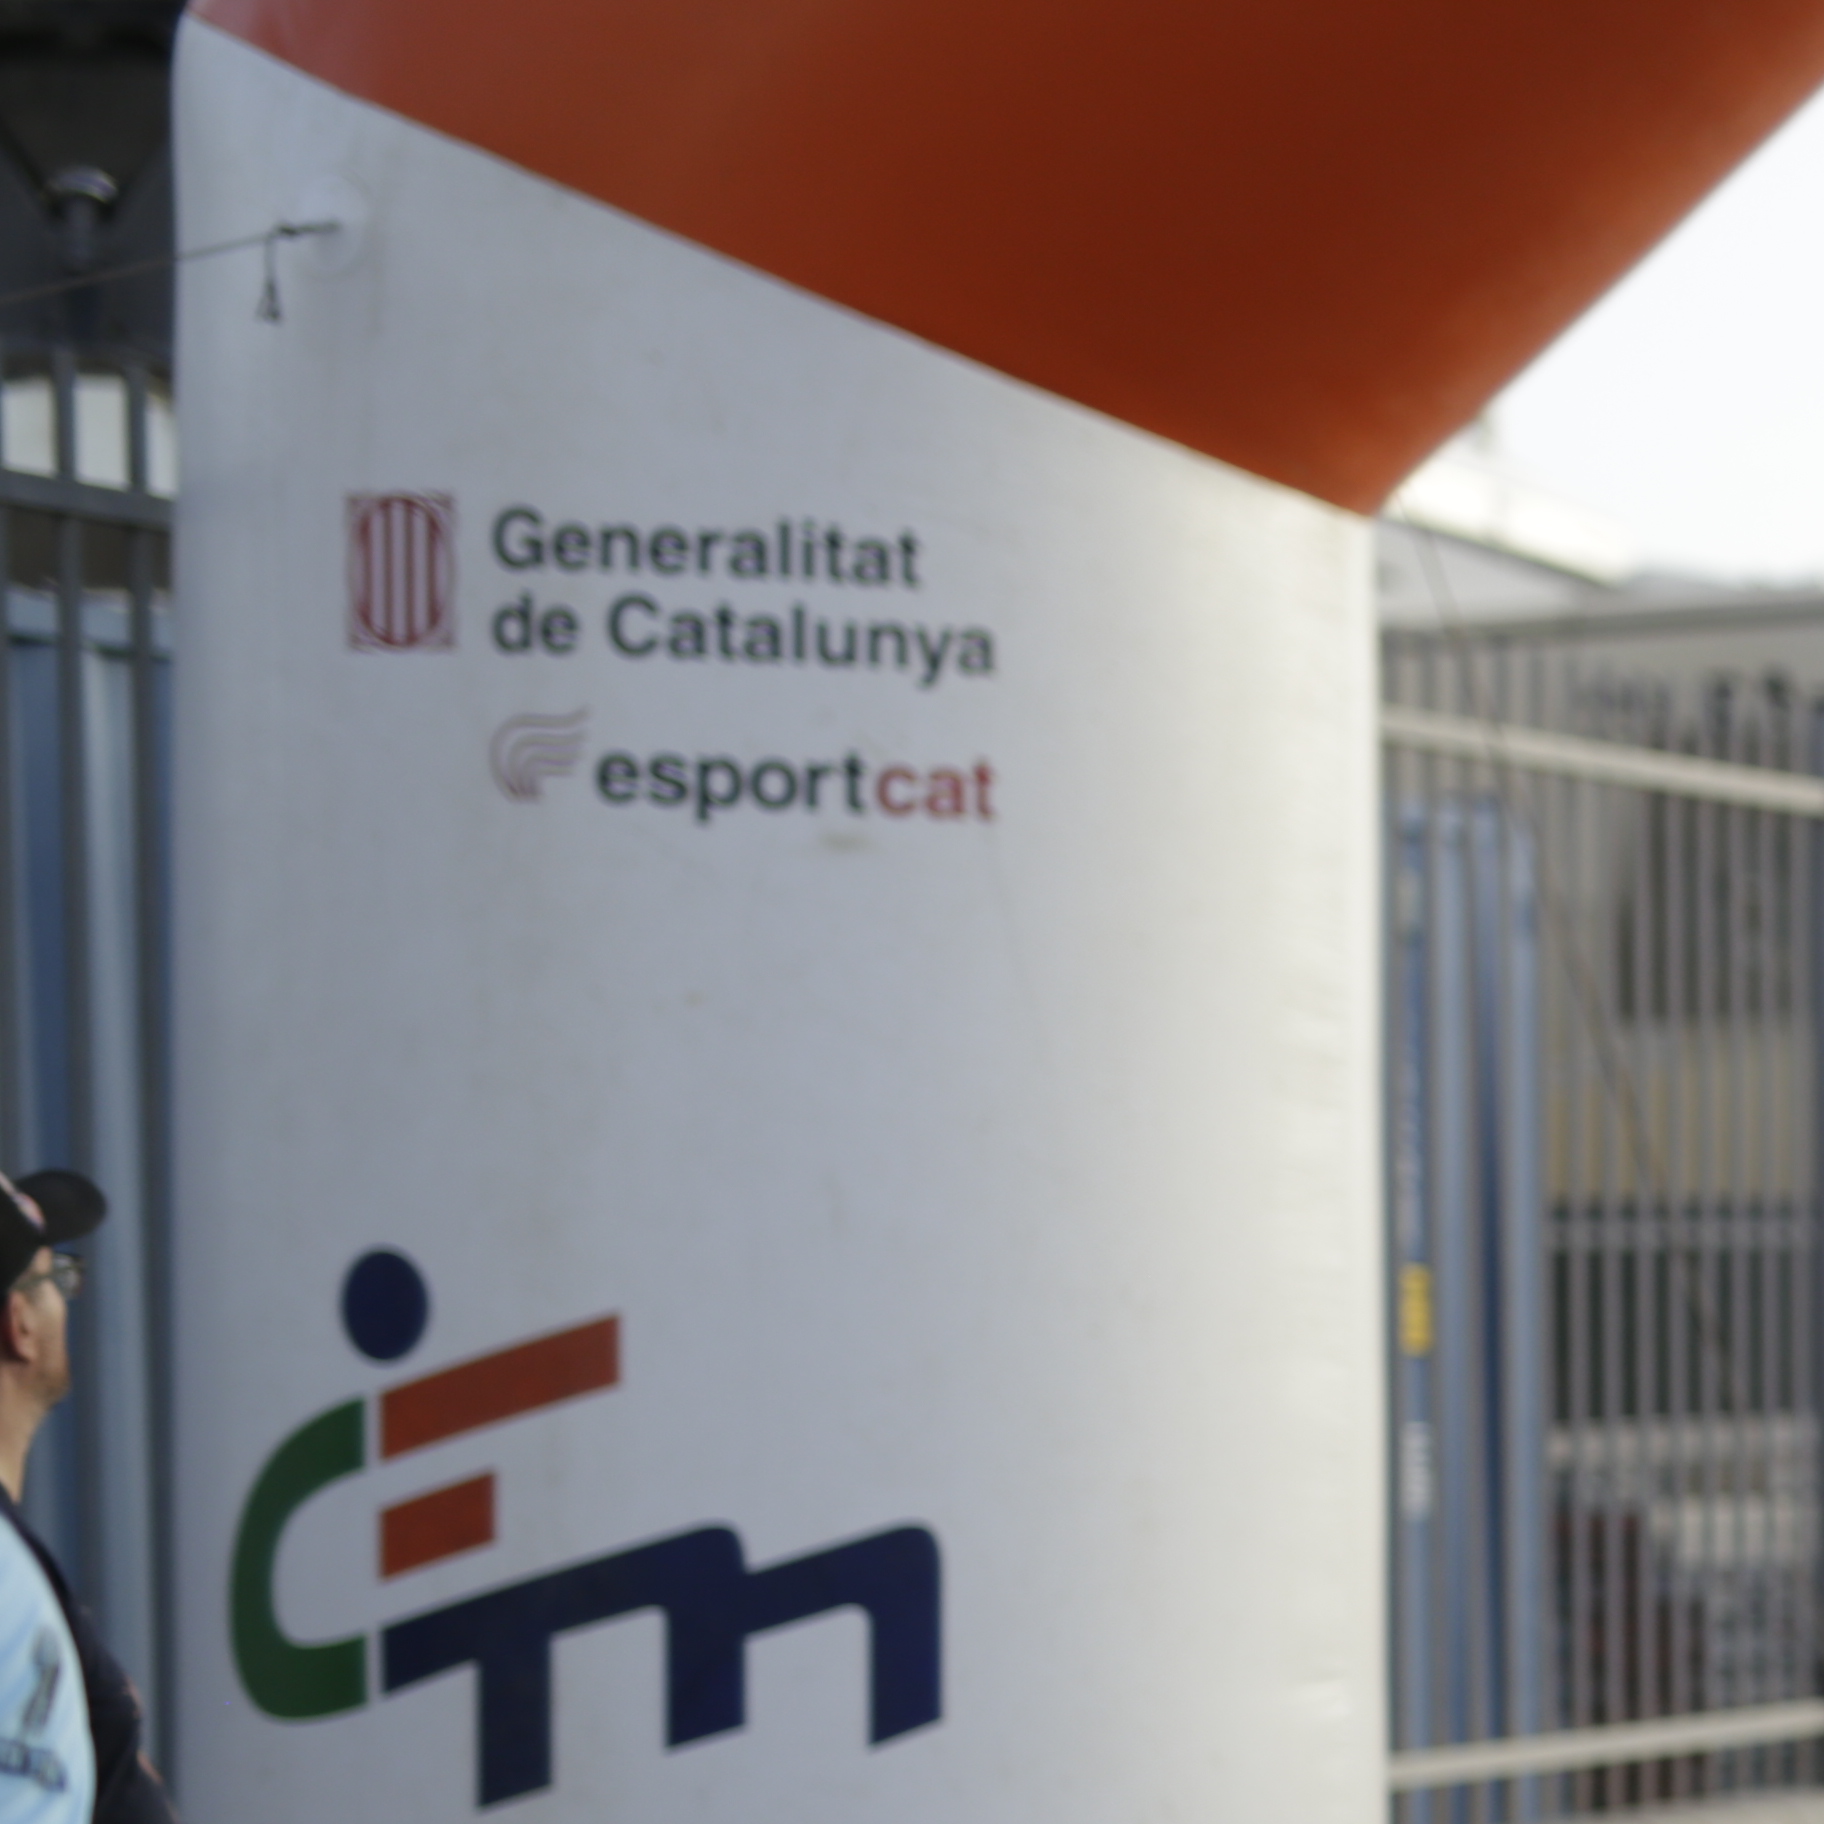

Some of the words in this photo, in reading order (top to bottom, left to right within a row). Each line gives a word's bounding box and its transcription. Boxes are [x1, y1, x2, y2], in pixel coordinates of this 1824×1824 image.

[491, 504, 918, 588] Generalitat
[491, 592, 578, 656] de
[607, 593, 995, 690] Catalunya
[595, 750, 995, 824] esportcat
